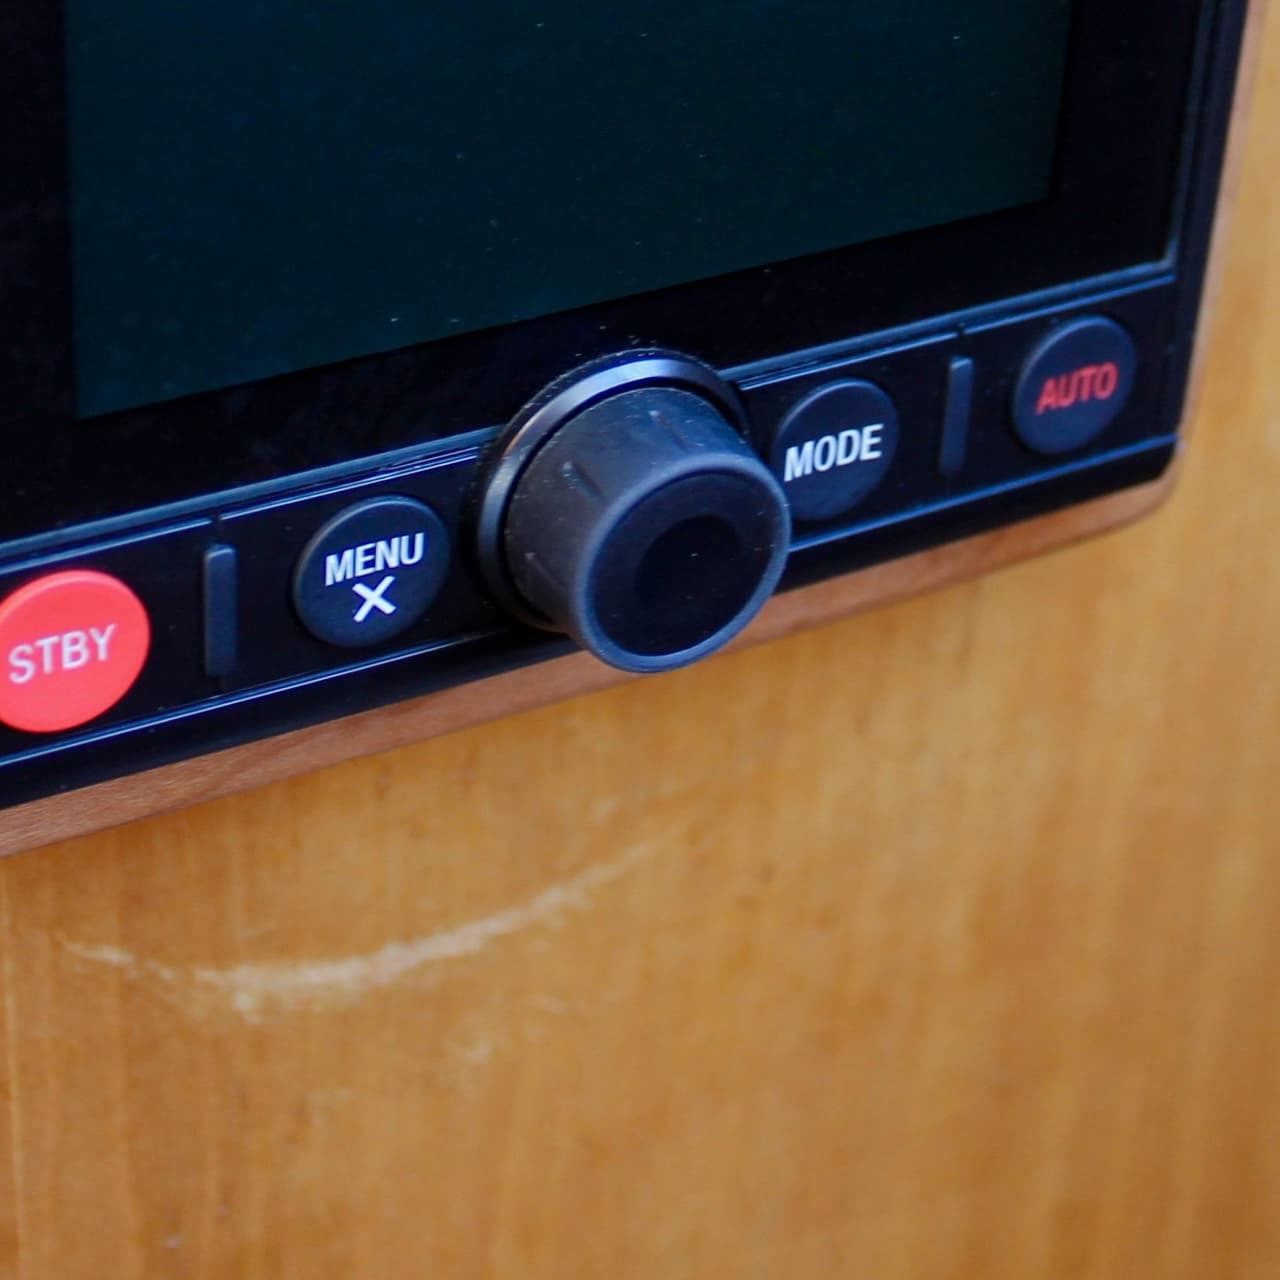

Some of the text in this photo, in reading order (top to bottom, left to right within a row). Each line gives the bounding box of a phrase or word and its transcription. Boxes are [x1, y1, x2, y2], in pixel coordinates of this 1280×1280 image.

[1035, 361, 1118, 415] AUTO
[783, 423, 884, 483] MODE
[324, 531, 425, 587] MENU
[6, 622, 117, 686] STBY
